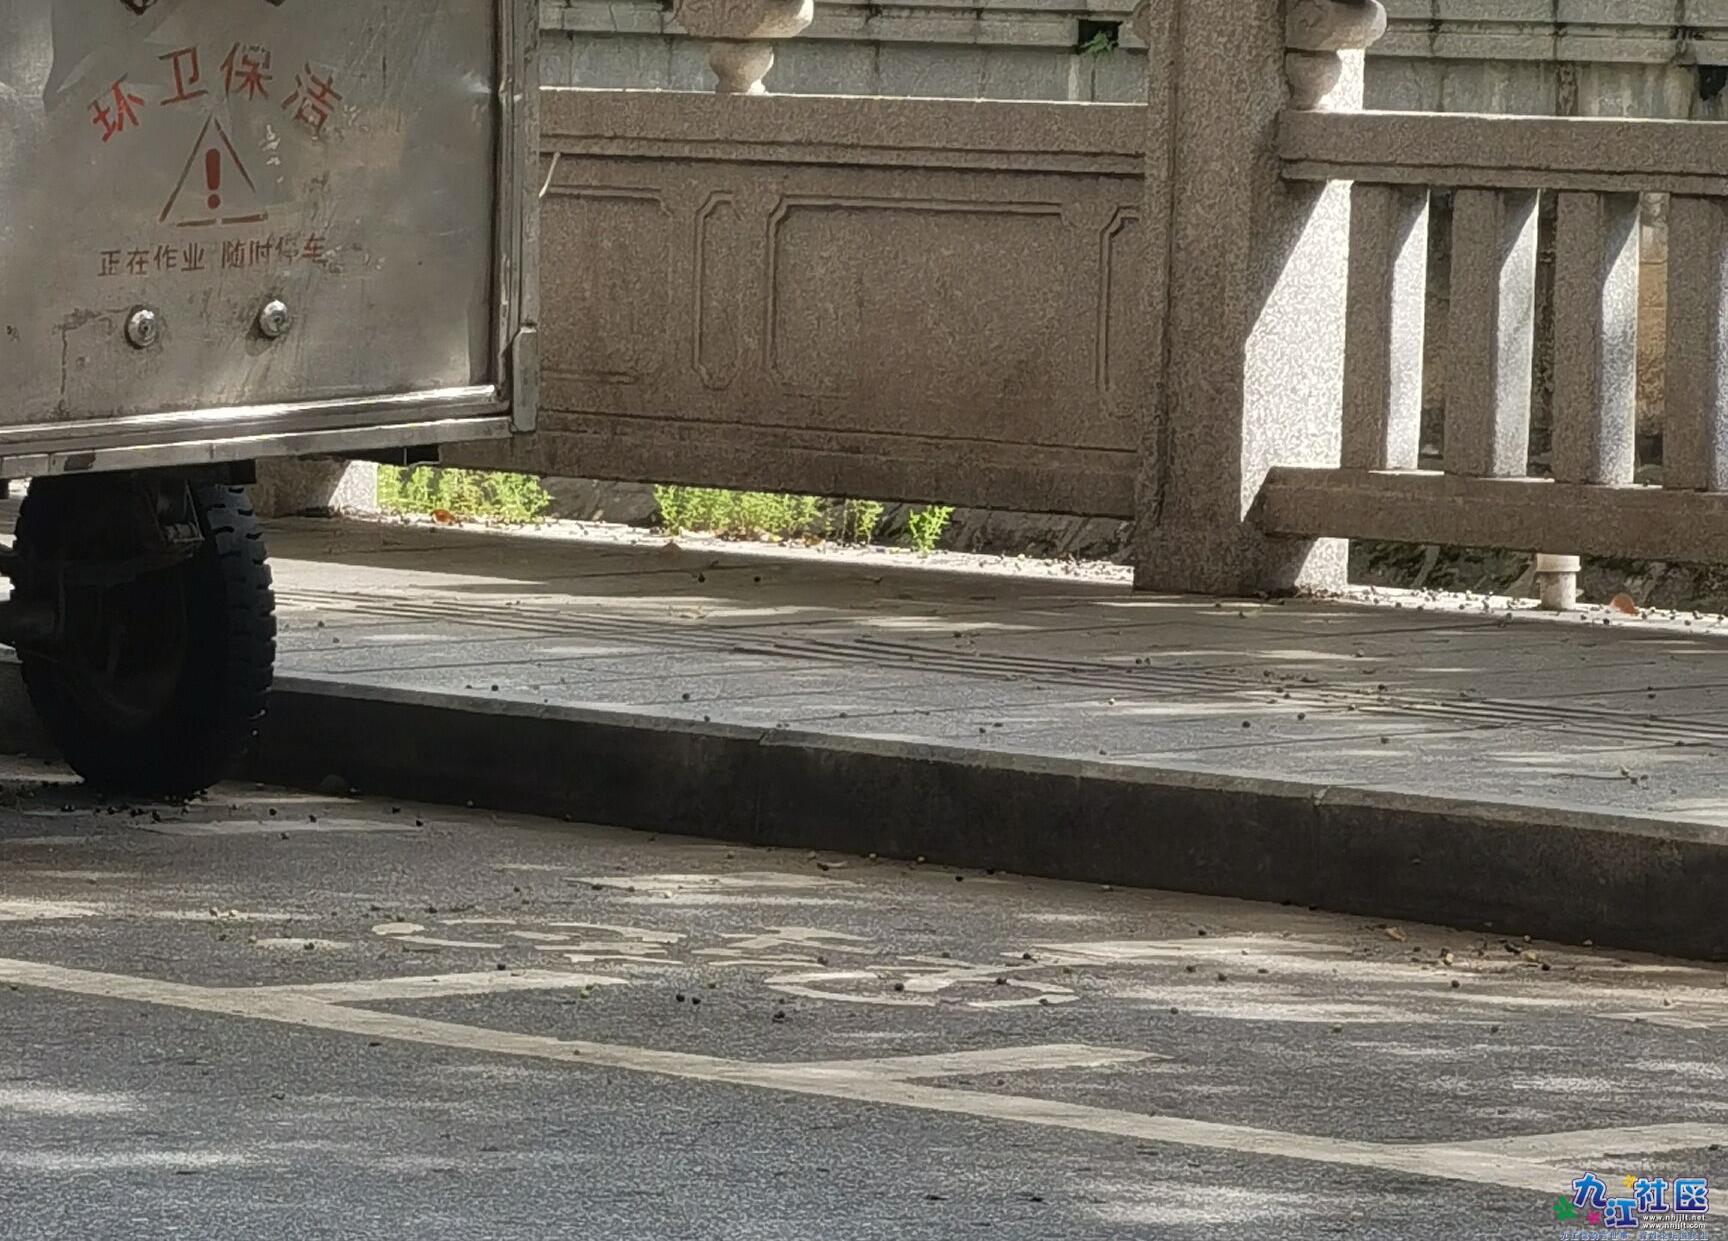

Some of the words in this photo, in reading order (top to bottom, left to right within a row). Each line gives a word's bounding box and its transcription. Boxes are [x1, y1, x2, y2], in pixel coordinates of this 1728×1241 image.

[88, 42, 343, 142] 环卫保洁
[98, 242, 205, 277] 正在作业
